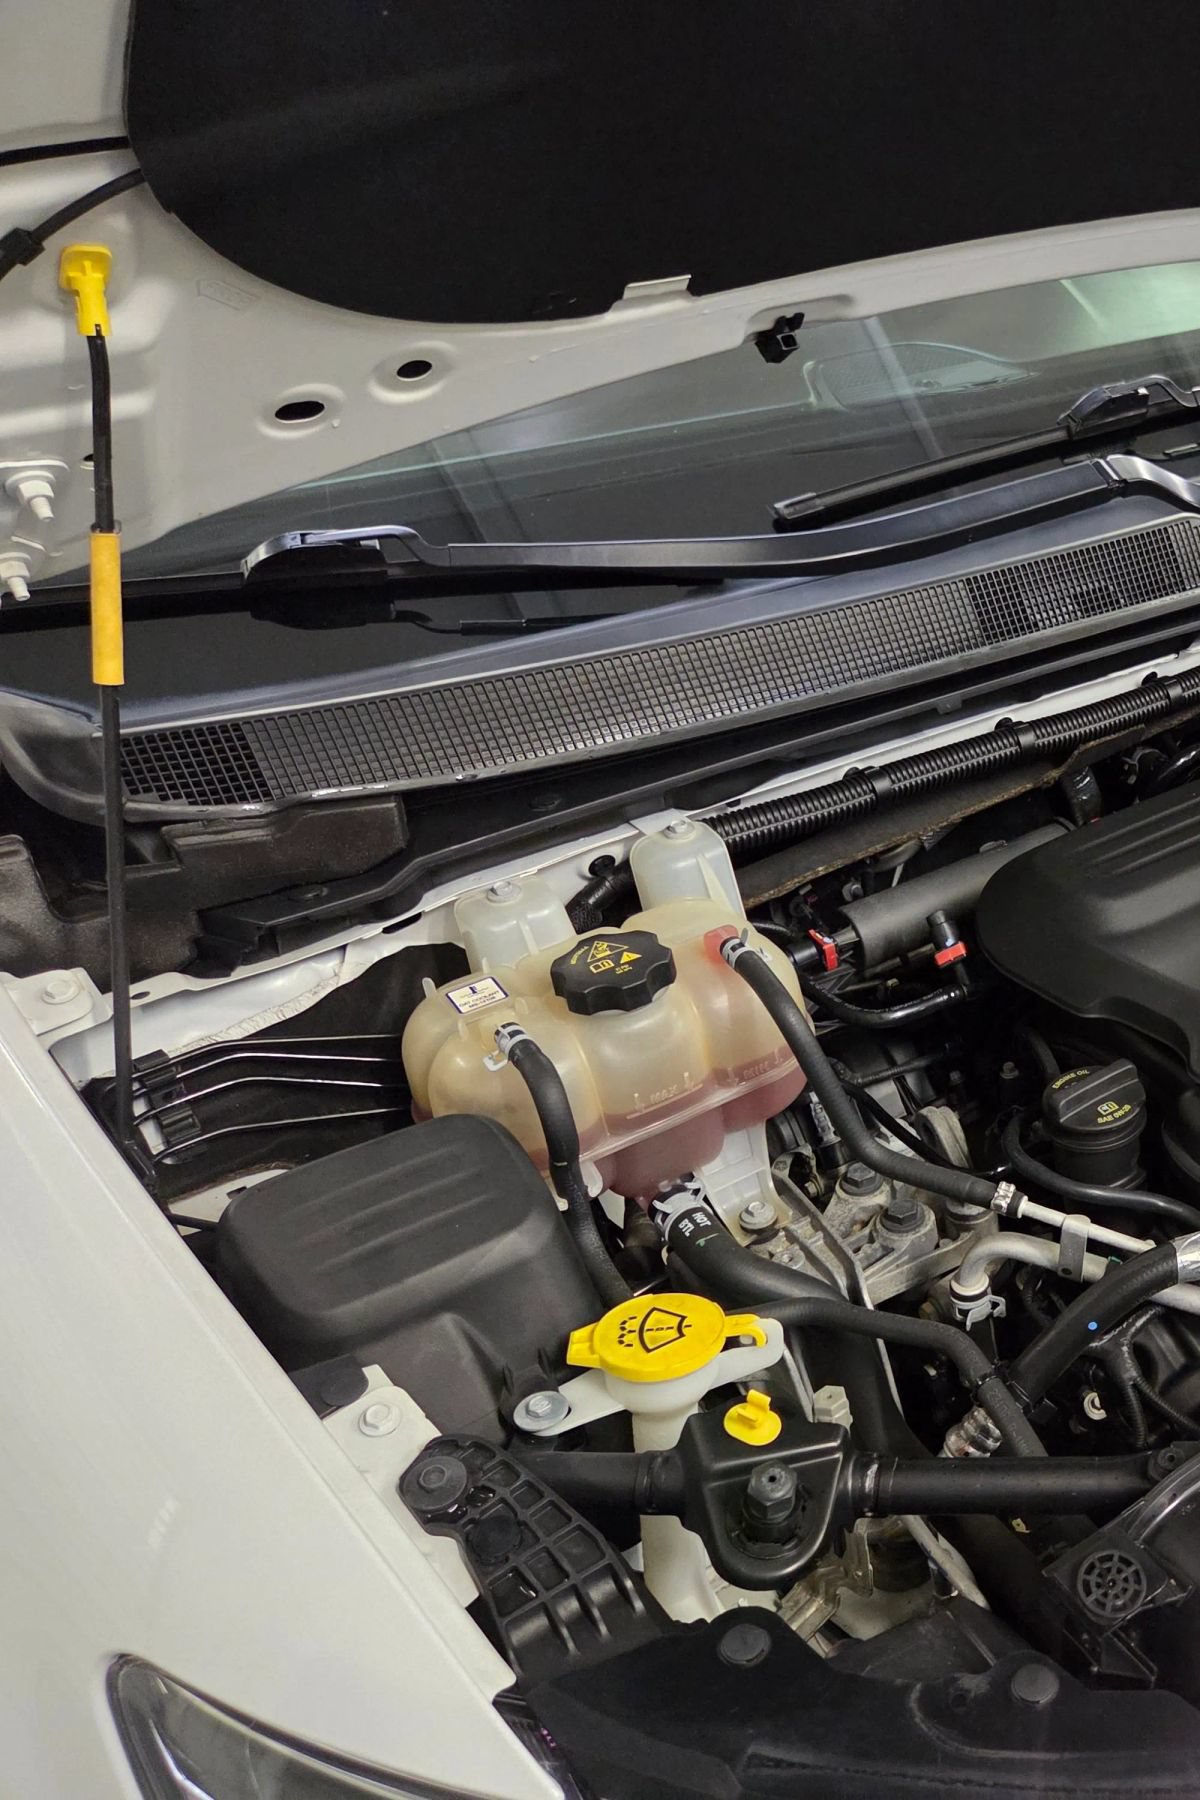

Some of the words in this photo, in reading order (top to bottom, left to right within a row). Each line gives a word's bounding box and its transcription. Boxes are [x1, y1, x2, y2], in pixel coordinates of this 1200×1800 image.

[1051, 1073, 1077, 1089] ENGINE
[1097, 1115, 1114, 1124] SAE
[691, 1211, 712, 1227] HOT
[678, 1218, 695, 1237] BTL
